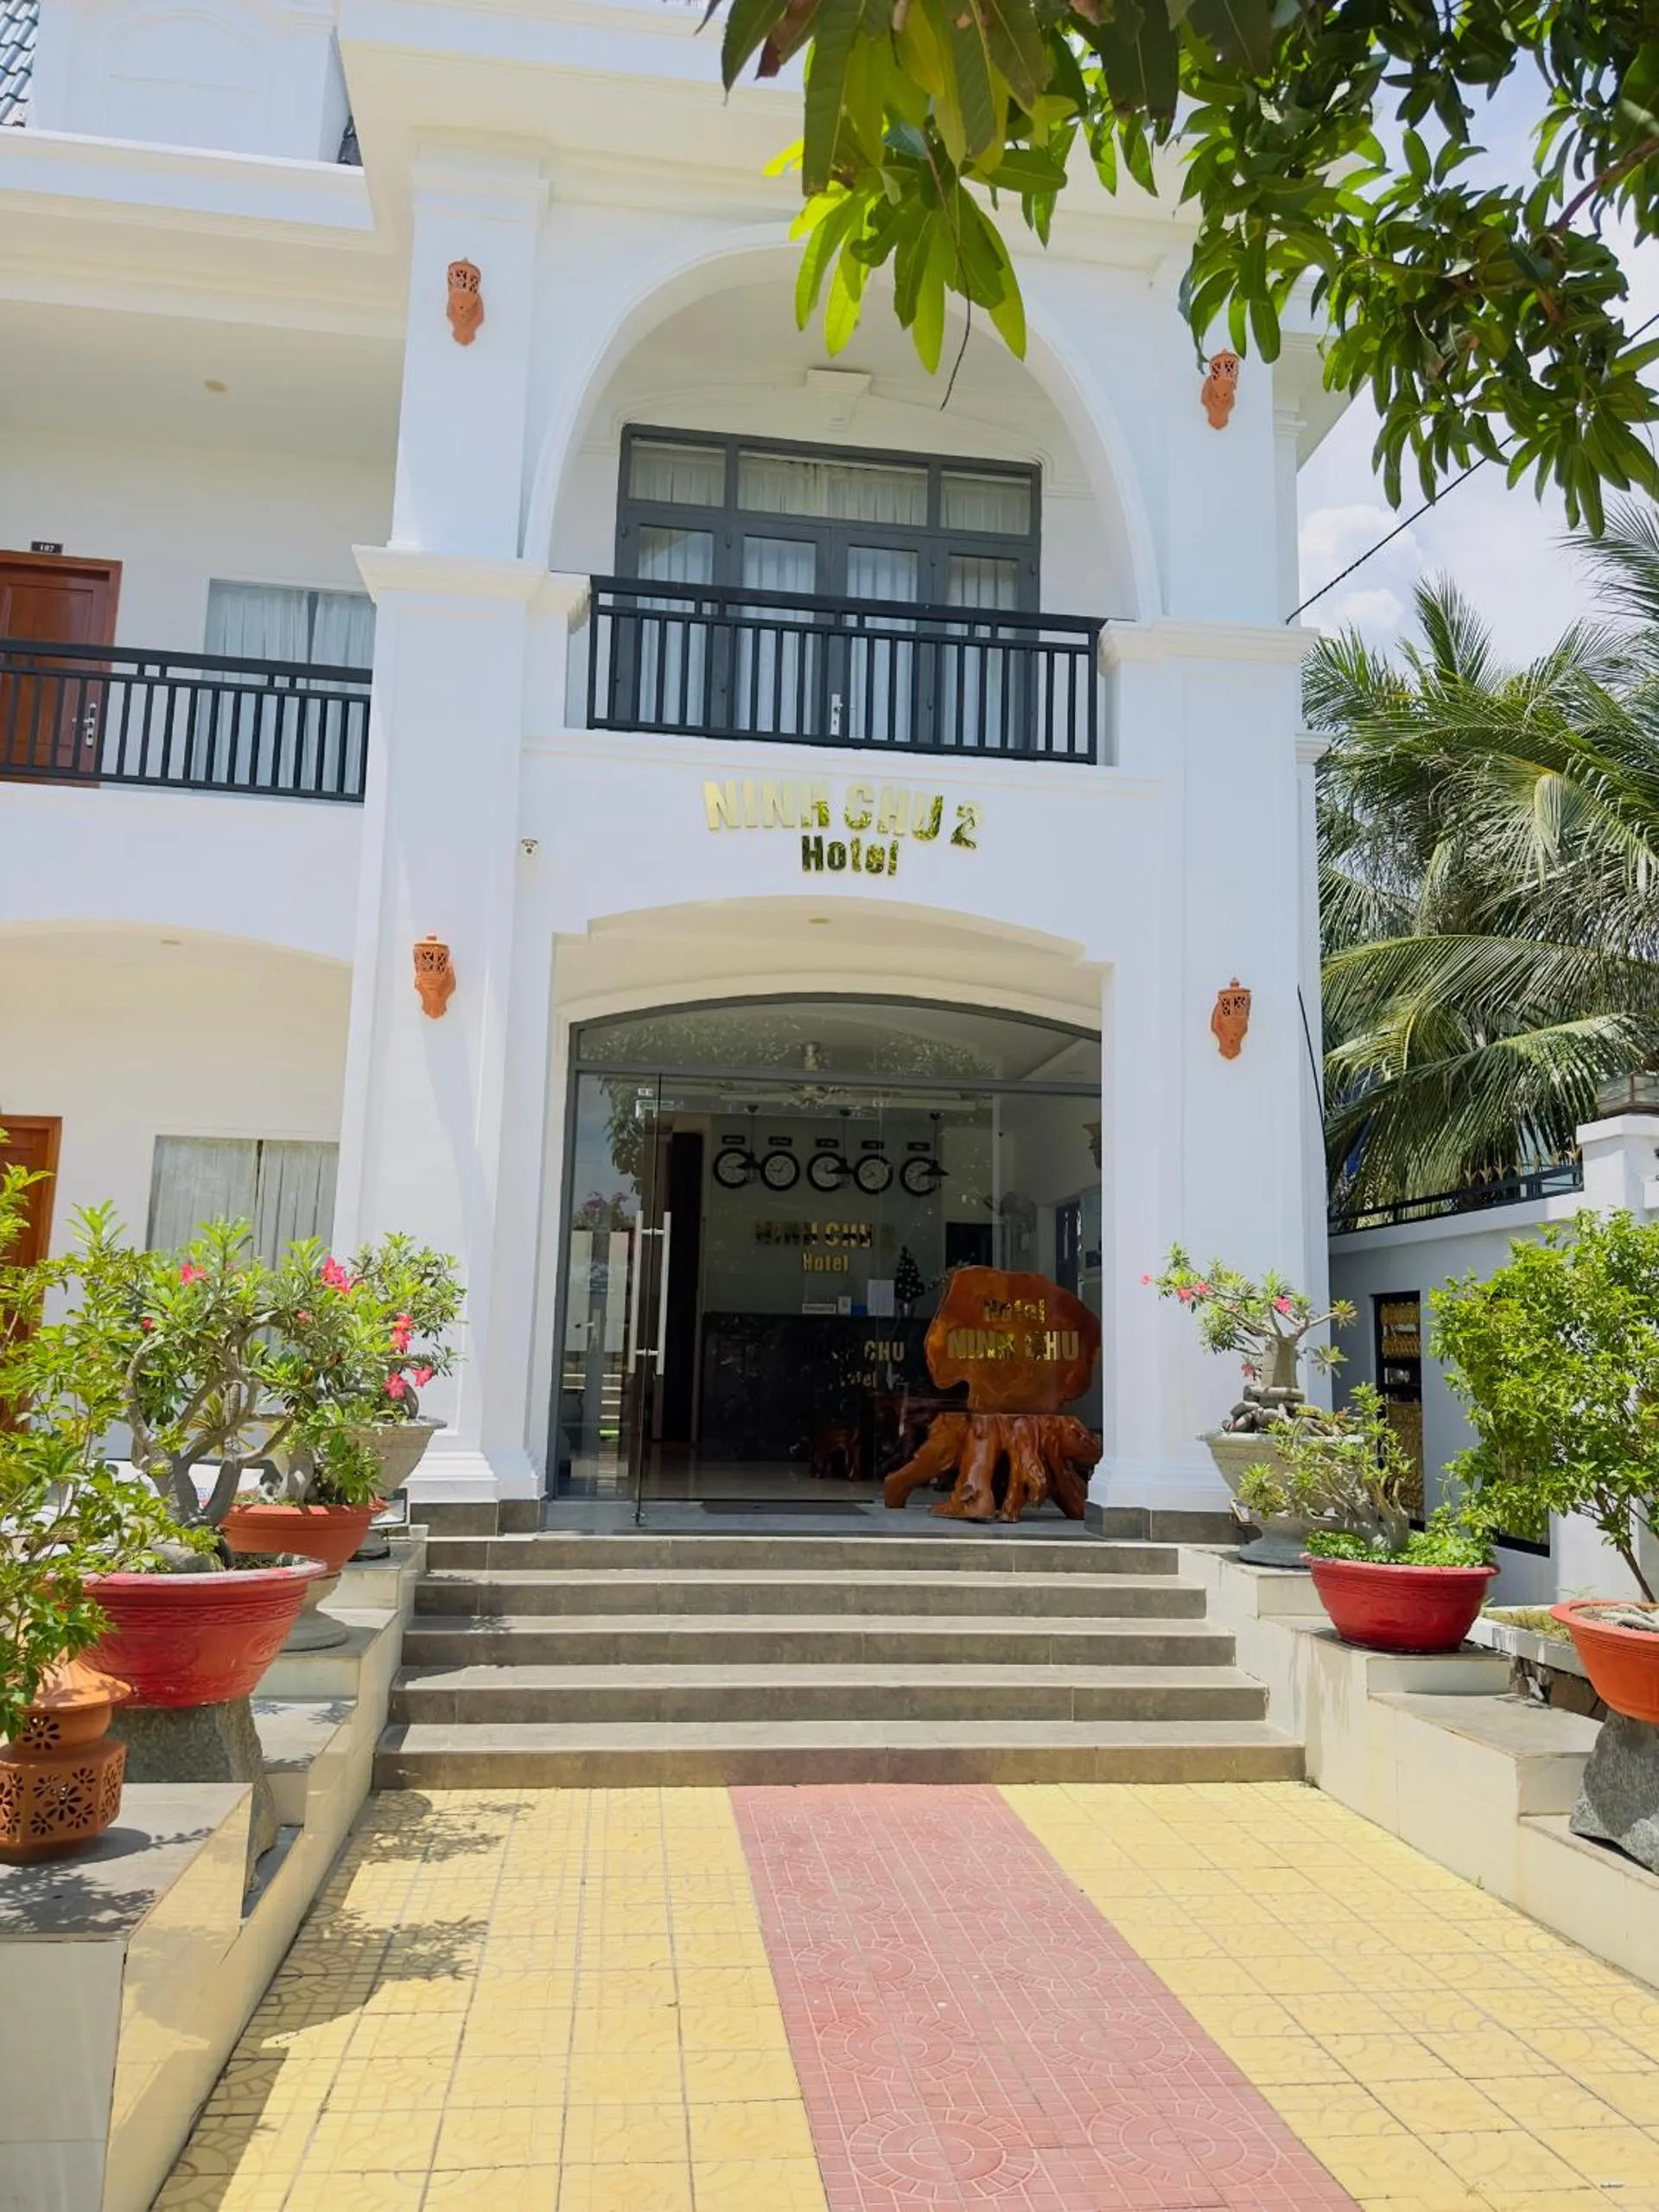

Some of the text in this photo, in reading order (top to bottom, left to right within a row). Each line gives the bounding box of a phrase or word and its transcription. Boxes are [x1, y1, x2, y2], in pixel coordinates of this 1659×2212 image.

[702, 779, 984, 849] NINH CHU 2
[800, 835, 899, 876] Hotel
[803, 1252, 849, 1274] Hotel
[982, 1299, 1046, 1324] Hotel
[864, 1339, 905, 1362] CHU
